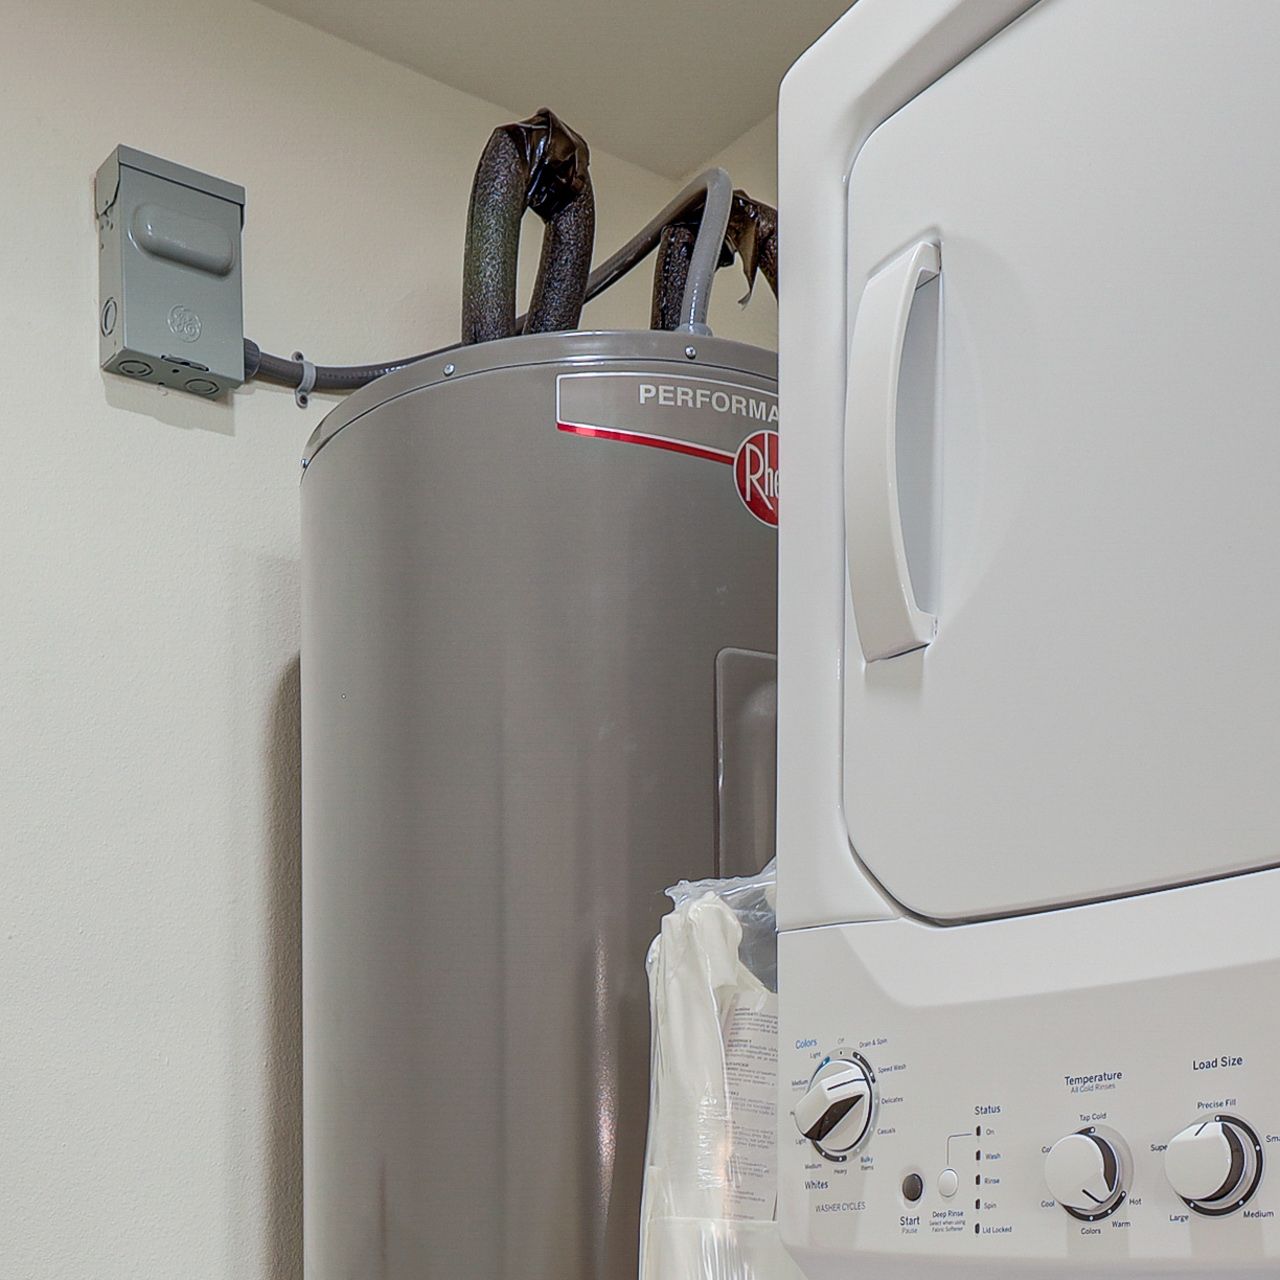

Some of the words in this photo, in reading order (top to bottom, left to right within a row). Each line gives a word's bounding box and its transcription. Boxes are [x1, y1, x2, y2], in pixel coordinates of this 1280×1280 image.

[639, 384, 778, 422] PERFORMA
[745, 431, 778, 511] Rhe
[795, 1038, 817, 1049] Colors
[1193, 1058, 1218, 1071] Load
[1220, 1056, 1243, 1067] Size
[1064, 1070, 1122, 1086] Temperature
[1197, 1100, 1223, 1110] Precise
[1225, 1098, 1237, 1107] Fill
[974, 1105, 1001, 1115] Status
[1079, 1114, 1090, 1122] Tap
[1092, 1112, 1107, 1121] Cold
[985, 1128, 995, 1136] On
[1150, 1143, 1168, 1152] Supe
[805, 1180, 828, 1190] Whites
[984, 1202, 997, 1210] Spin
[1041, 1200, 1055, 1208] Cool
[1129, 1198, 1141, 1206] Hot
[815, 1203, 841, 1213] WASHER
[841, 1201, 866, 1211] CYCLES
[932, 1211, 946, 1219] Deep
[1169, 1214, 1189, 1223] Large
[1243, 1210, 1274, 1219] Medium
[900, 1216, 920, 1226] Start
[1112, 1220, 1131, 1228] Warm
[982, 1226, 991, 1234] Lid
[1080, 1227, 1101, 1235] Colors
